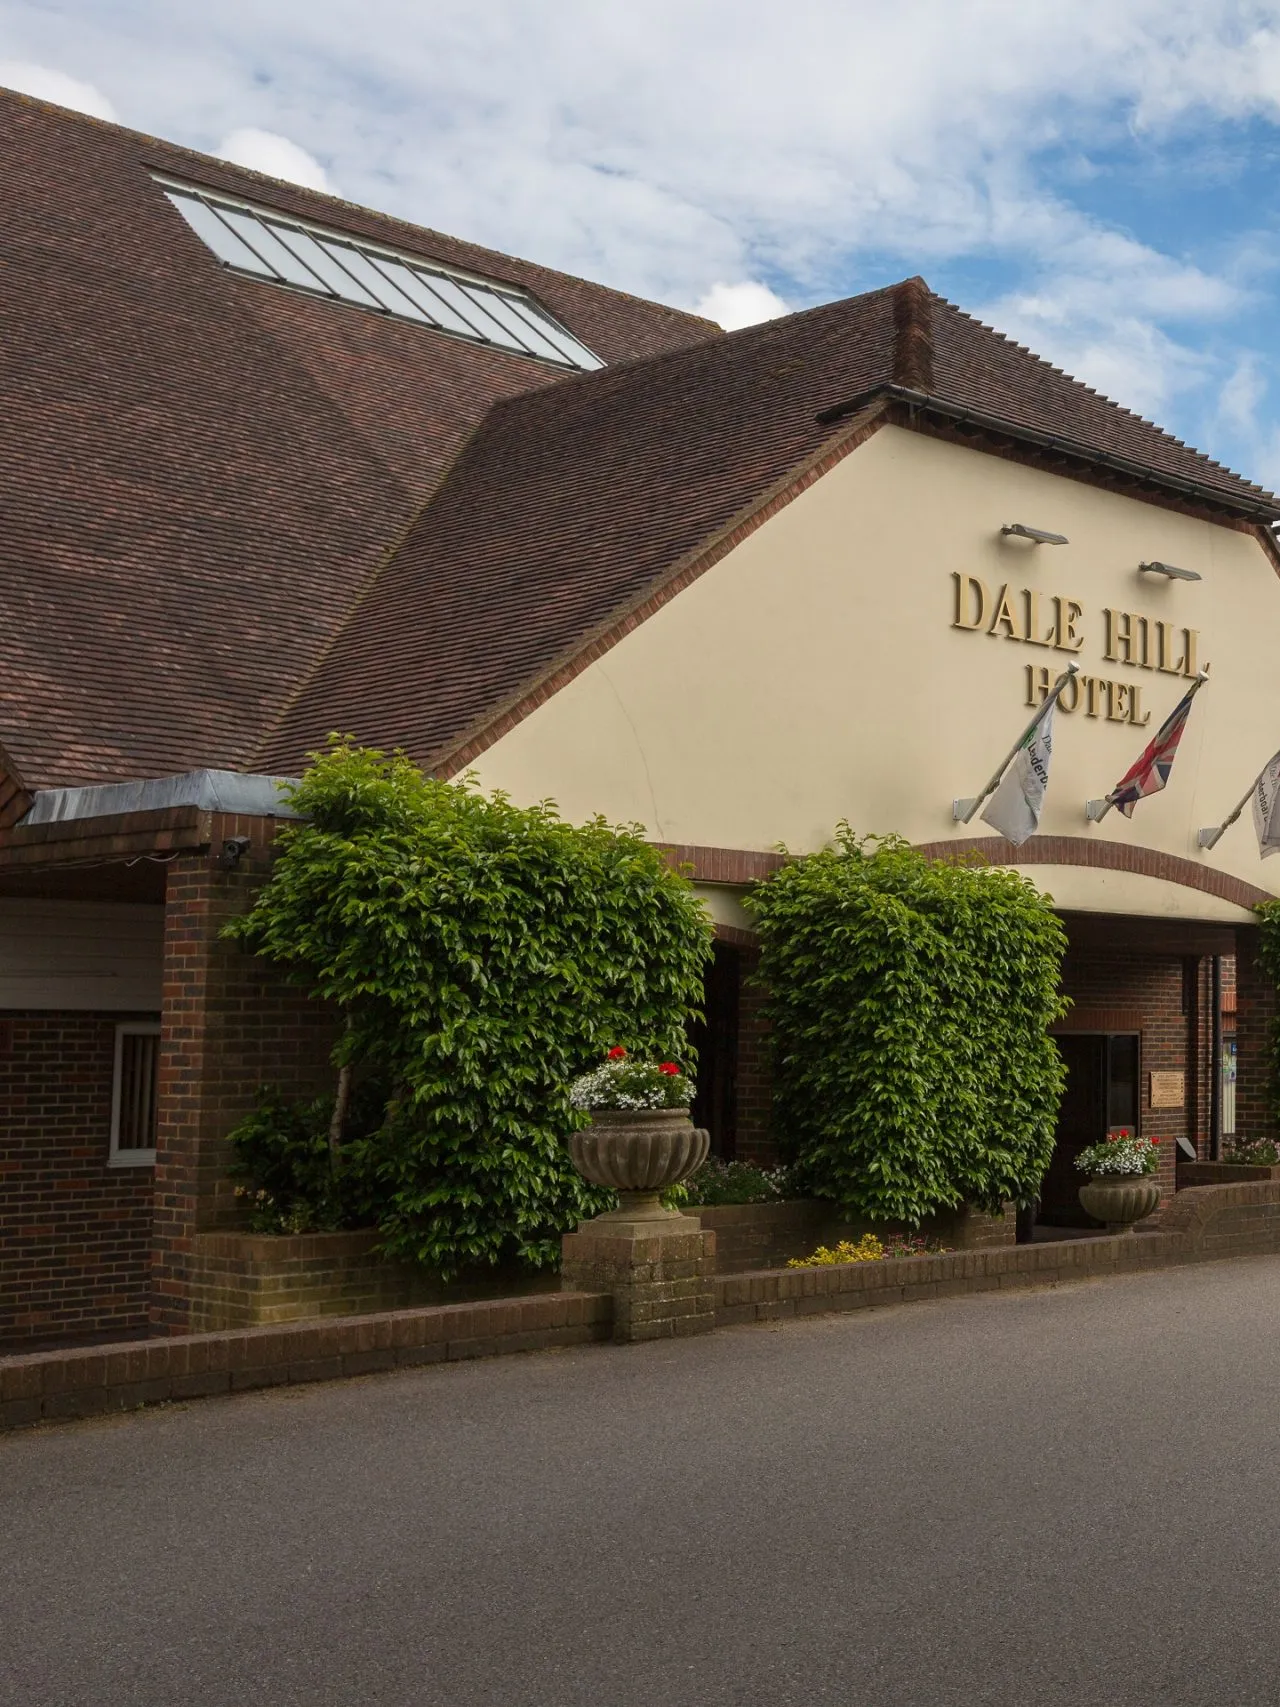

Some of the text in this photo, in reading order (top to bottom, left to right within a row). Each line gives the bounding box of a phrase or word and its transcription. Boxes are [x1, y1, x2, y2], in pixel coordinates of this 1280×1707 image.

[952, 572, 1210, 681] DALE HILL
[1025, 664, 1151, 727] HOTEL
